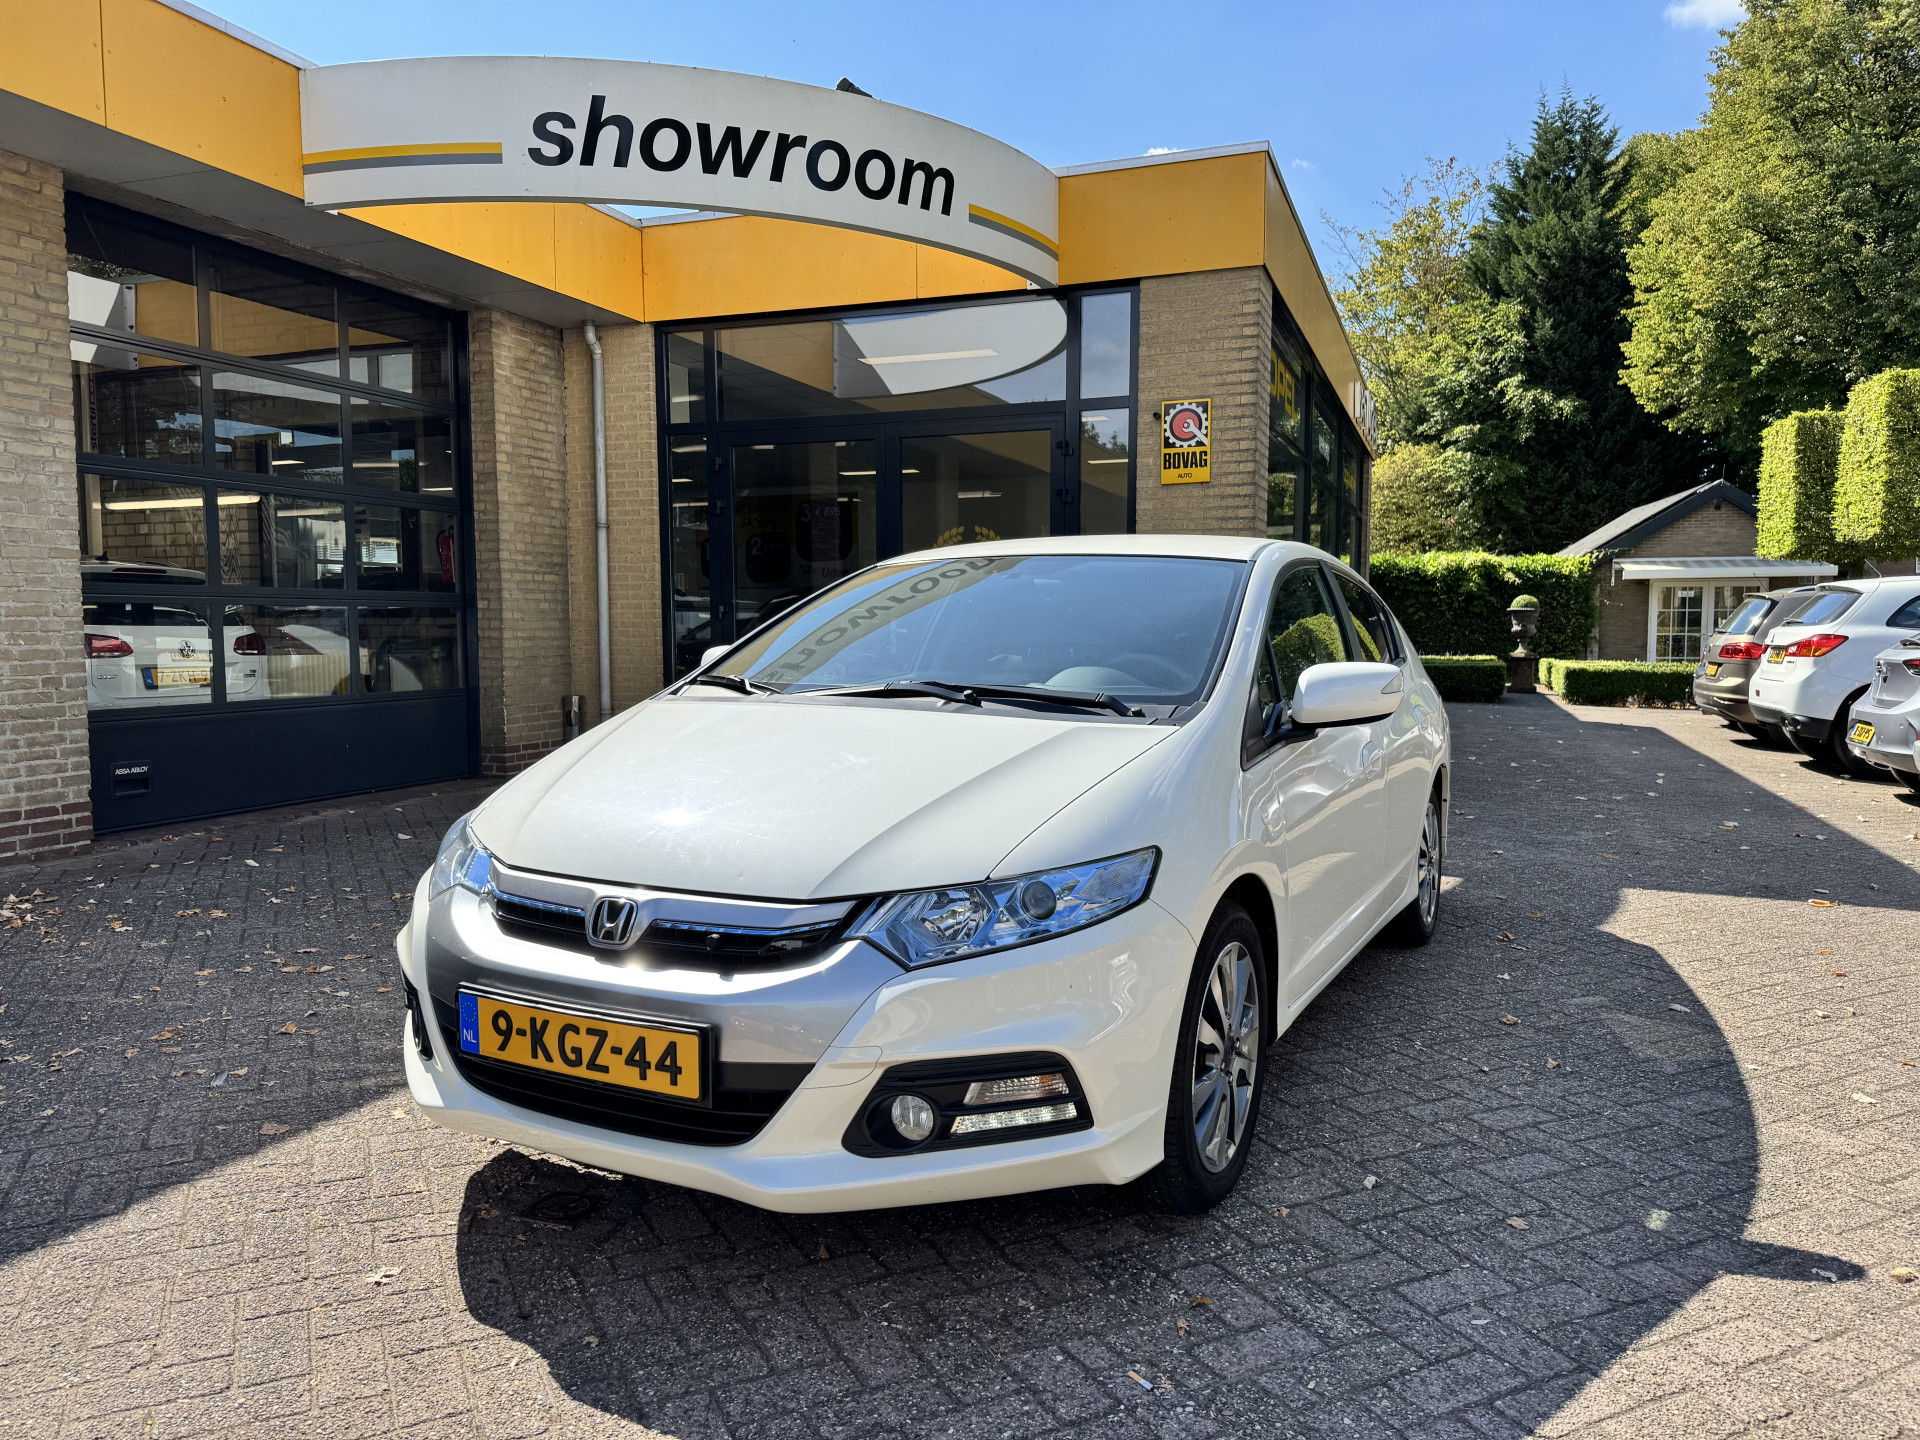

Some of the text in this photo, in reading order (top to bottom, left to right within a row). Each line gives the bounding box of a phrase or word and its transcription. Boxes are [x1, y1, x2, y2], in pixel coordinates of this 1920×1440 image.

[527, 94, 956, 217] showroom
[1163, 451, 1208, 470] BOVAG
[158, 670, 208, 683] 7-ZKH-9
[131, 766, 149, 774] ABLOY
[463, 1028, 477, 1043] NL
[491, 1009, 683, 1086] 9-KGZ-44
